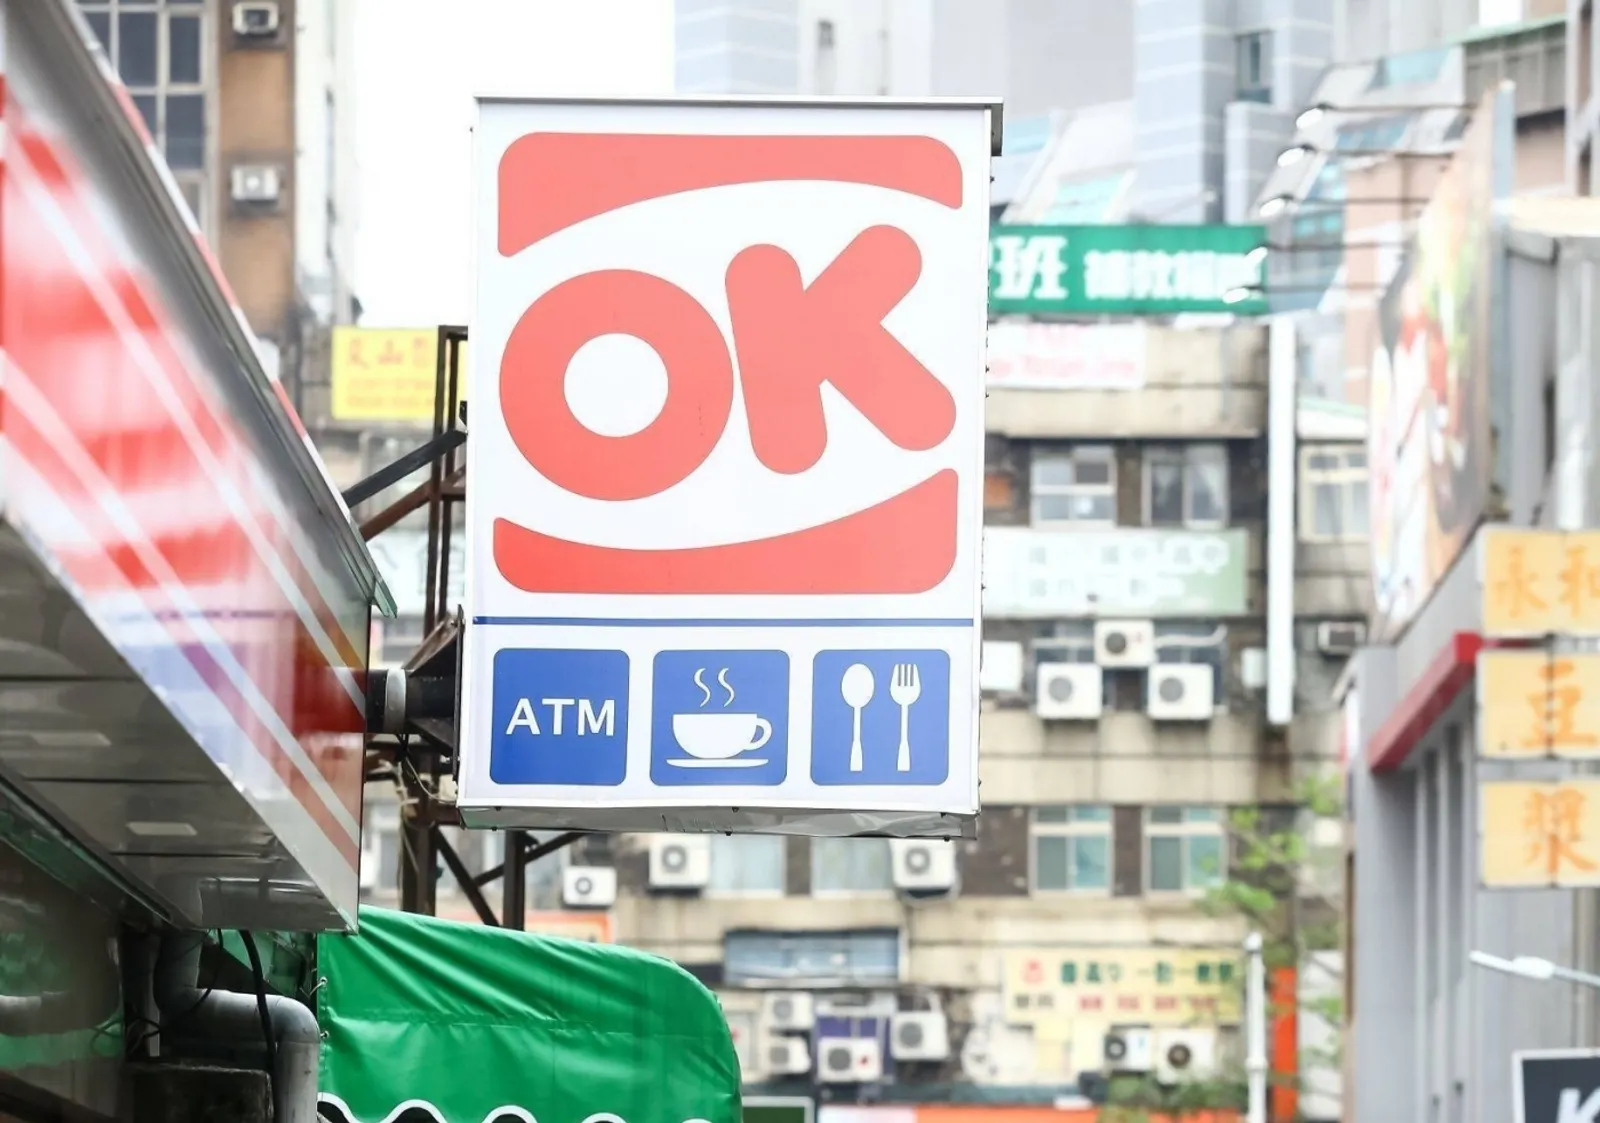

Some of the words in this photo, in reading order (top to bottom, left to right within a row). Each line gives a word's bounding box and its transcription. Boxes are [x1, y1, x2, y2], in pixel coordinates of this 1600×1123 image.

[988, 235, 1069, 300] 班
[499, 223, 957, 502] OK
[505, 697, 616, 737] ATM
